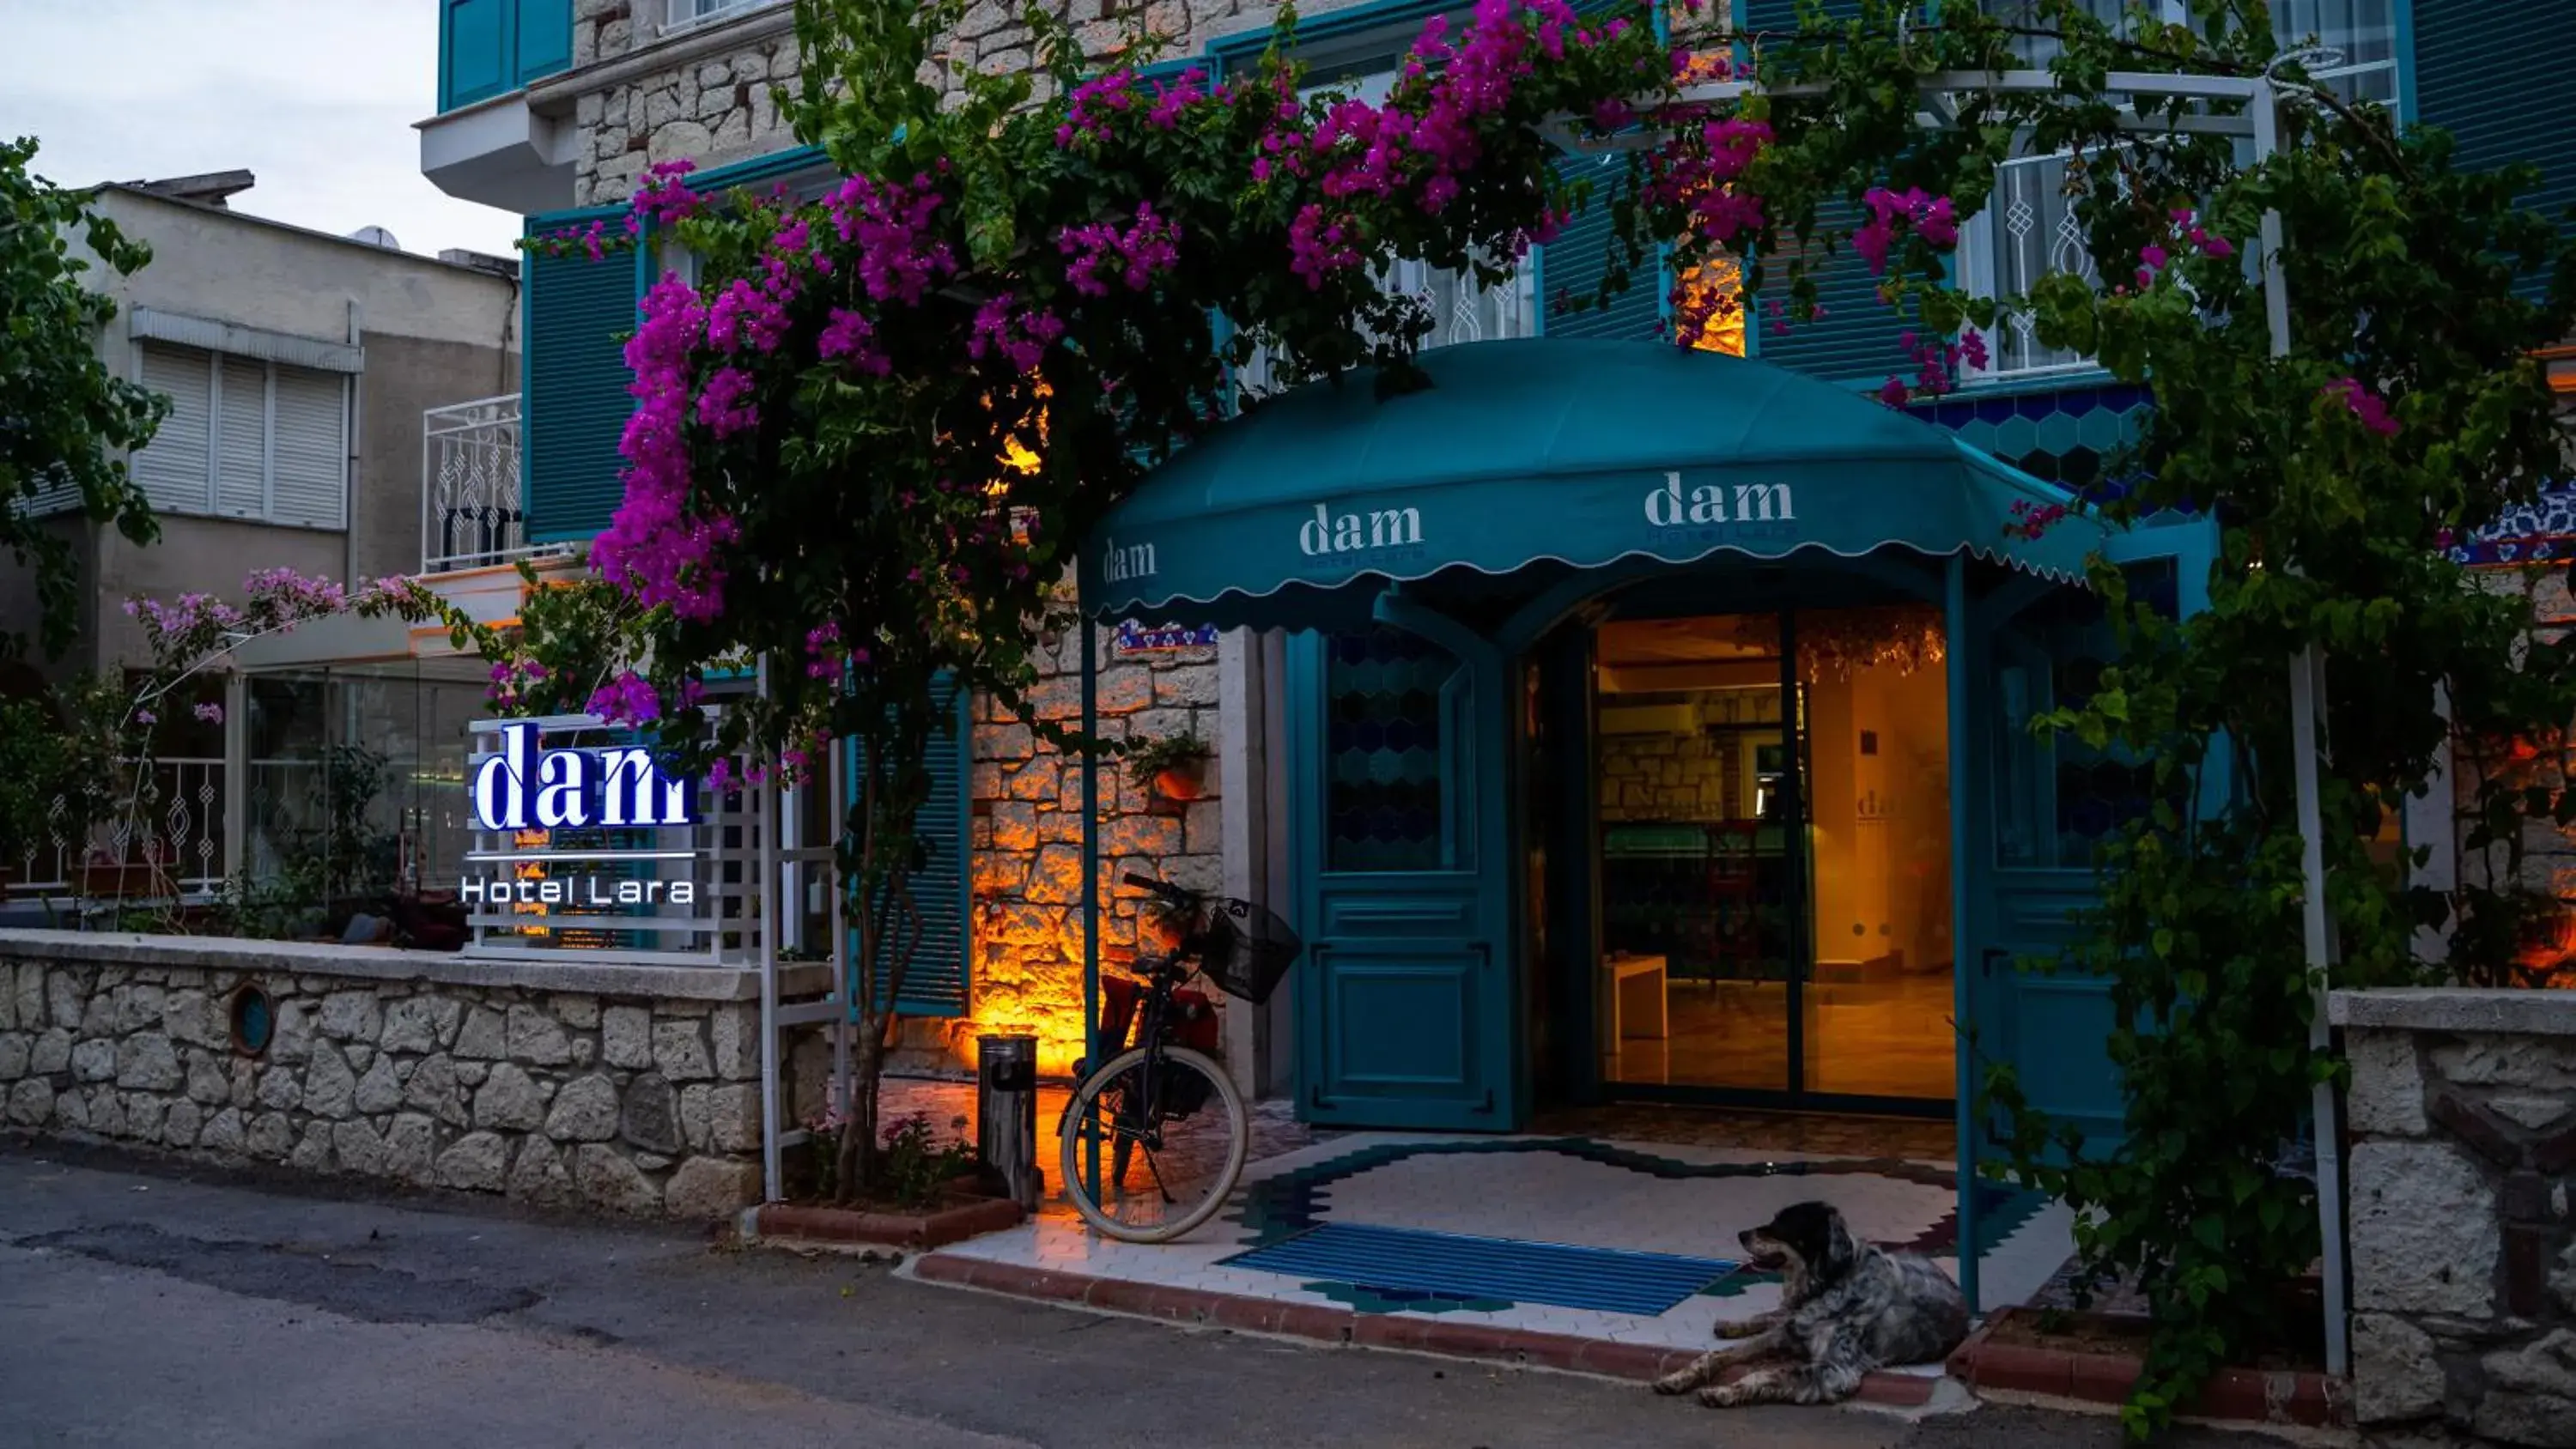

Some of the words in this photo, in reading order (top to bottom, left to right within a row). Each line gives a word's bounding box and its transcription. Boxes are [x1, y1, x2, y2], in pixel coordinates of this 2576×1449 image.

[1643, 471, 1797, 526] dam
[1299, 502, 1425, 555] dam
[1103, 537, 1157, 585] dam
[461, 876, 574, 903] Hotel
[590, 876, 695, 903] Lara
